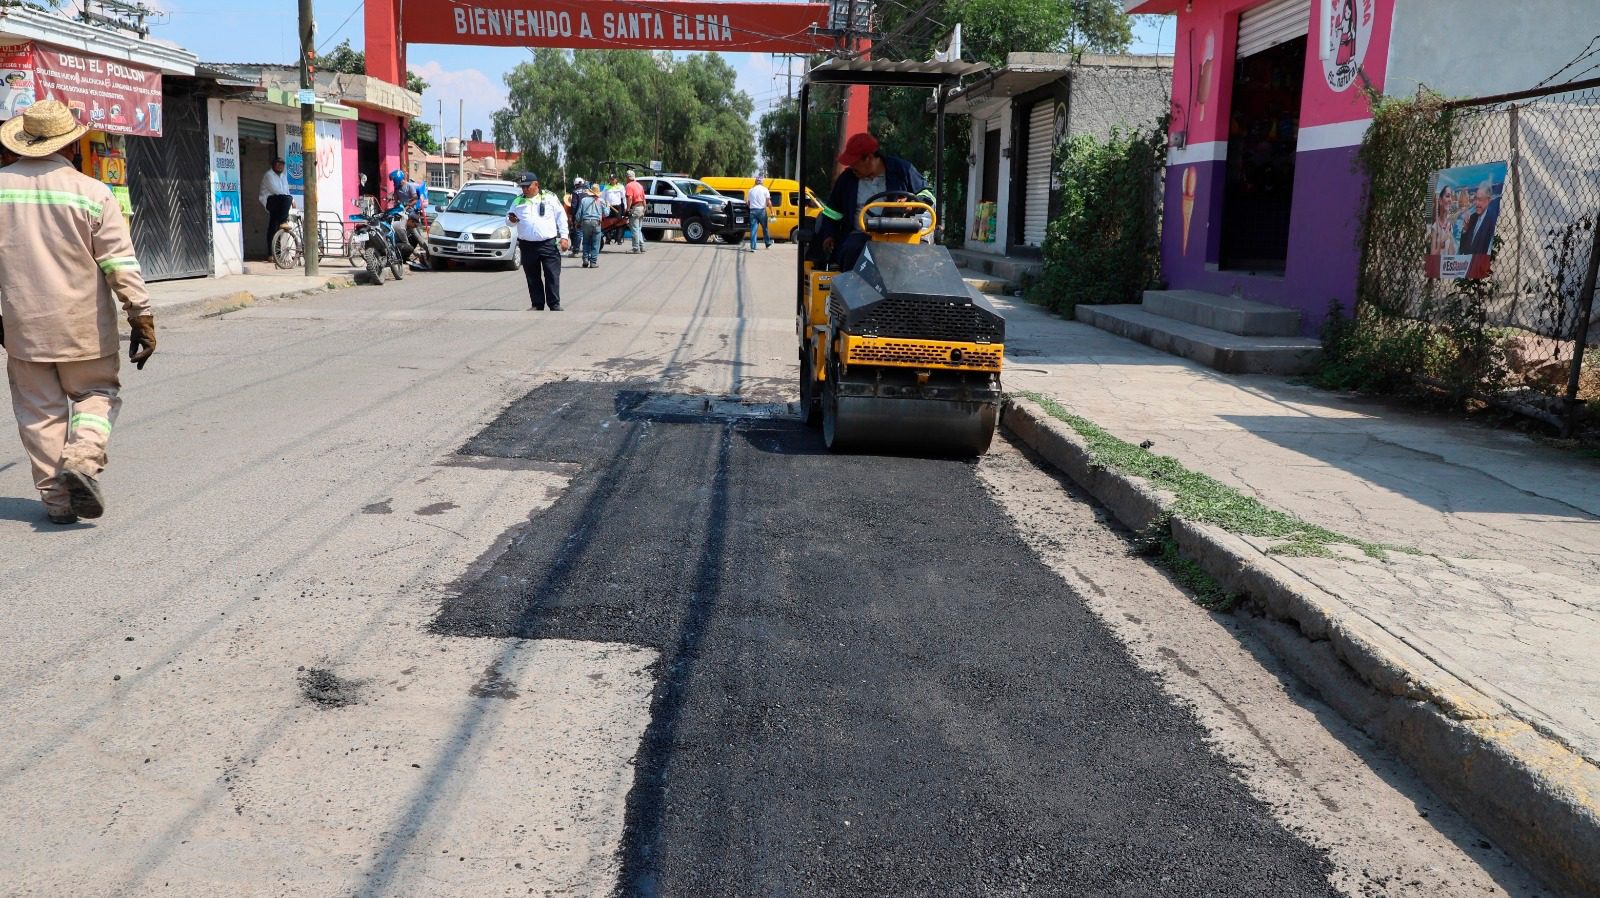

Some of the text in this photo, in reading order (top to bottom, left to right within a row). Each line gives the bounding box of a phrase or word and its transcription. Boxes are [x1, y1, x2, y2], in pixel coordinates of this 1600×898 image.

[453, 7, 733, 42] BIENVENIDO A SANTA ELENA
[59, 54, 145, 83] DELI EL POLLON
